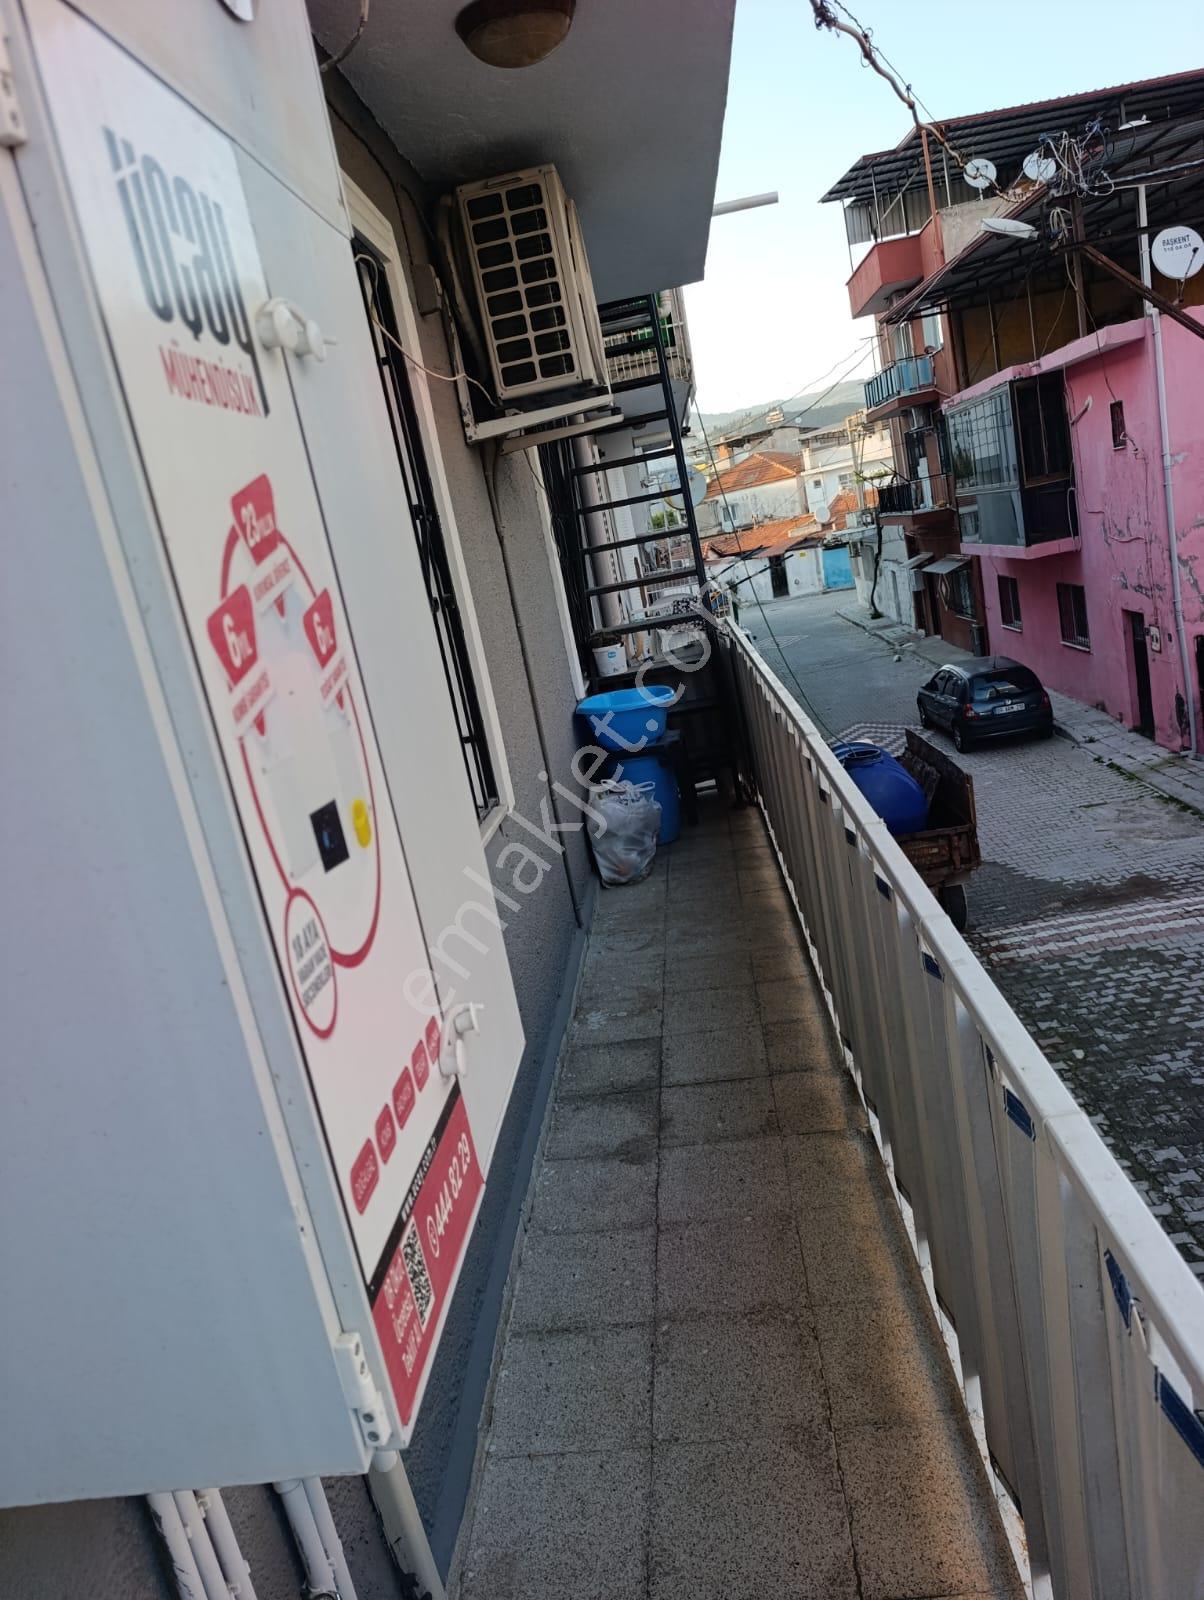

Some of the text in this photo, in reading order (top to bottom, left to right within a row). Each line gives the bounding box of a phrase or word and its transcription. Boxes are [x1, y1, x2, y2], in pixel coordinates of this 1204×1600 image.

[435, 1132, 471, 1236] 444 82 29
